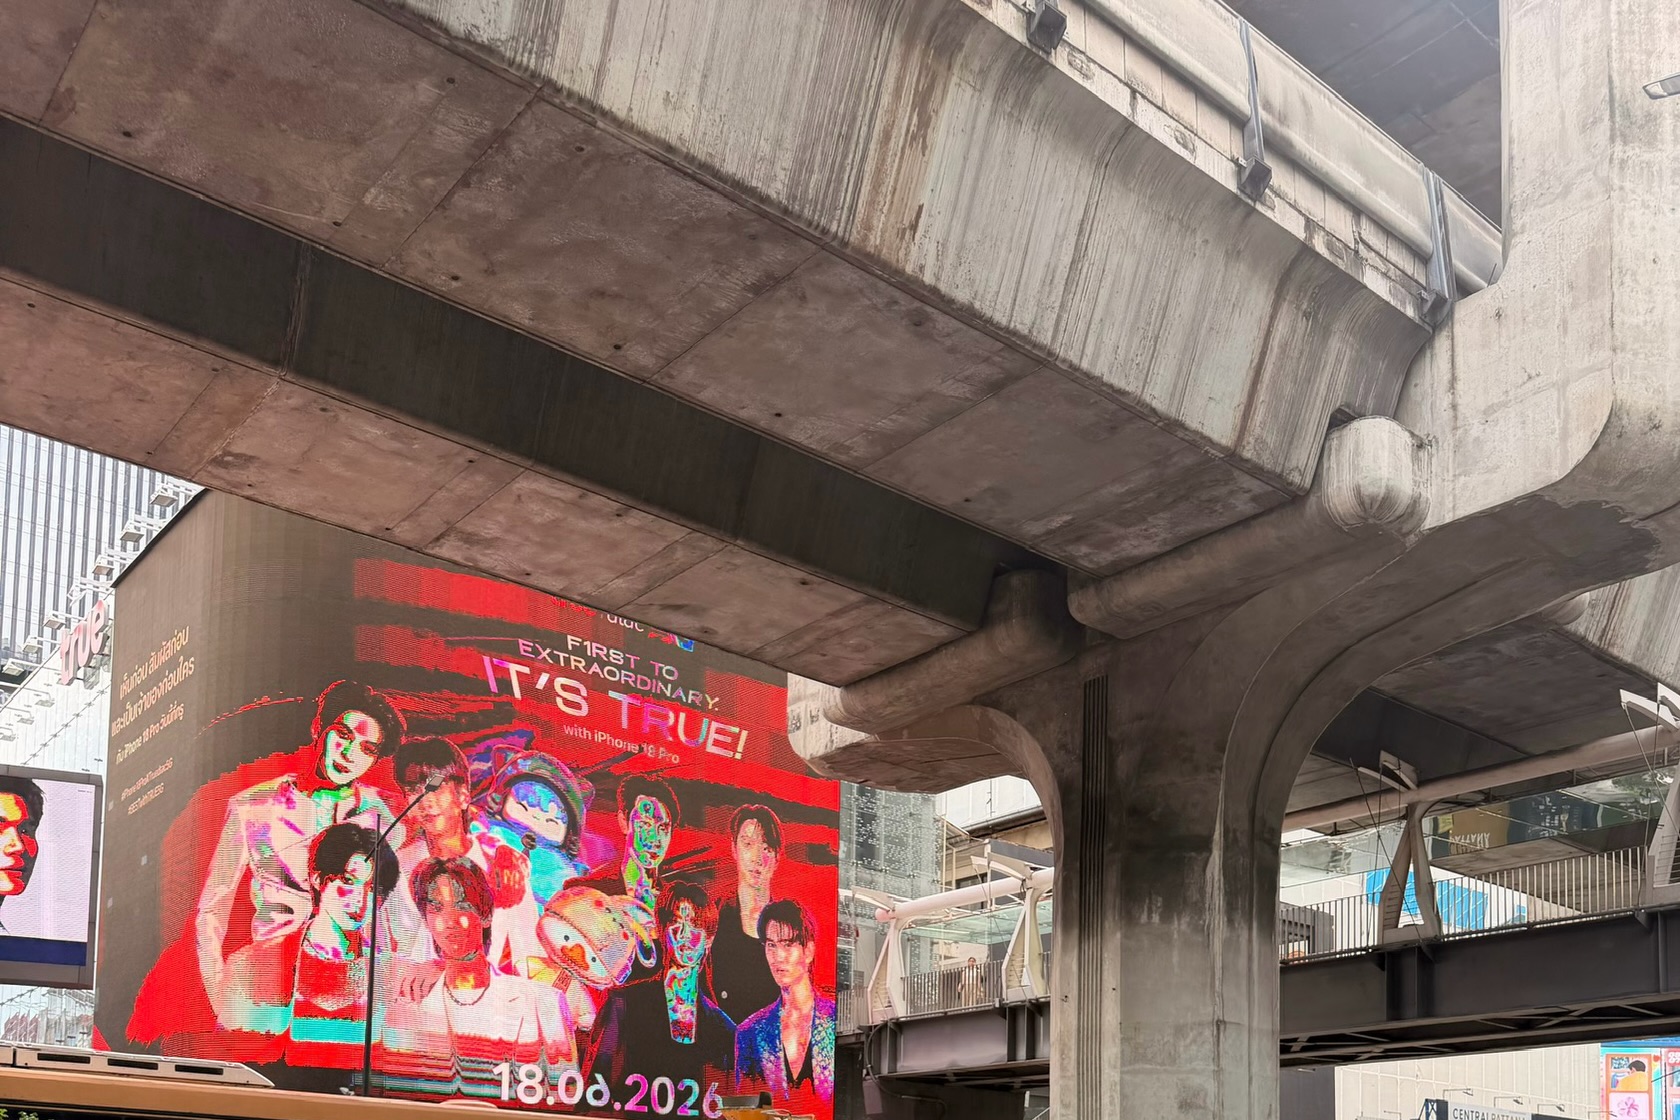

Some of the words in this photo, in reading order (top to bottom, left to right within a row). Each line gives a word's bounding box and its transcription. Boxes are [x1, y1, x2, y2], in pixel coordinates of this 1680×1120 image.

[60, 600, 107, 685] true
[518, 638, 719, 711] EXTRAORDINARY.
[650, 660, 679, 681] TO
[563, 724, 592, 740] with
[594, 729, 640, 754] iPhone
[608, 690, 748, 760] TRUE!
